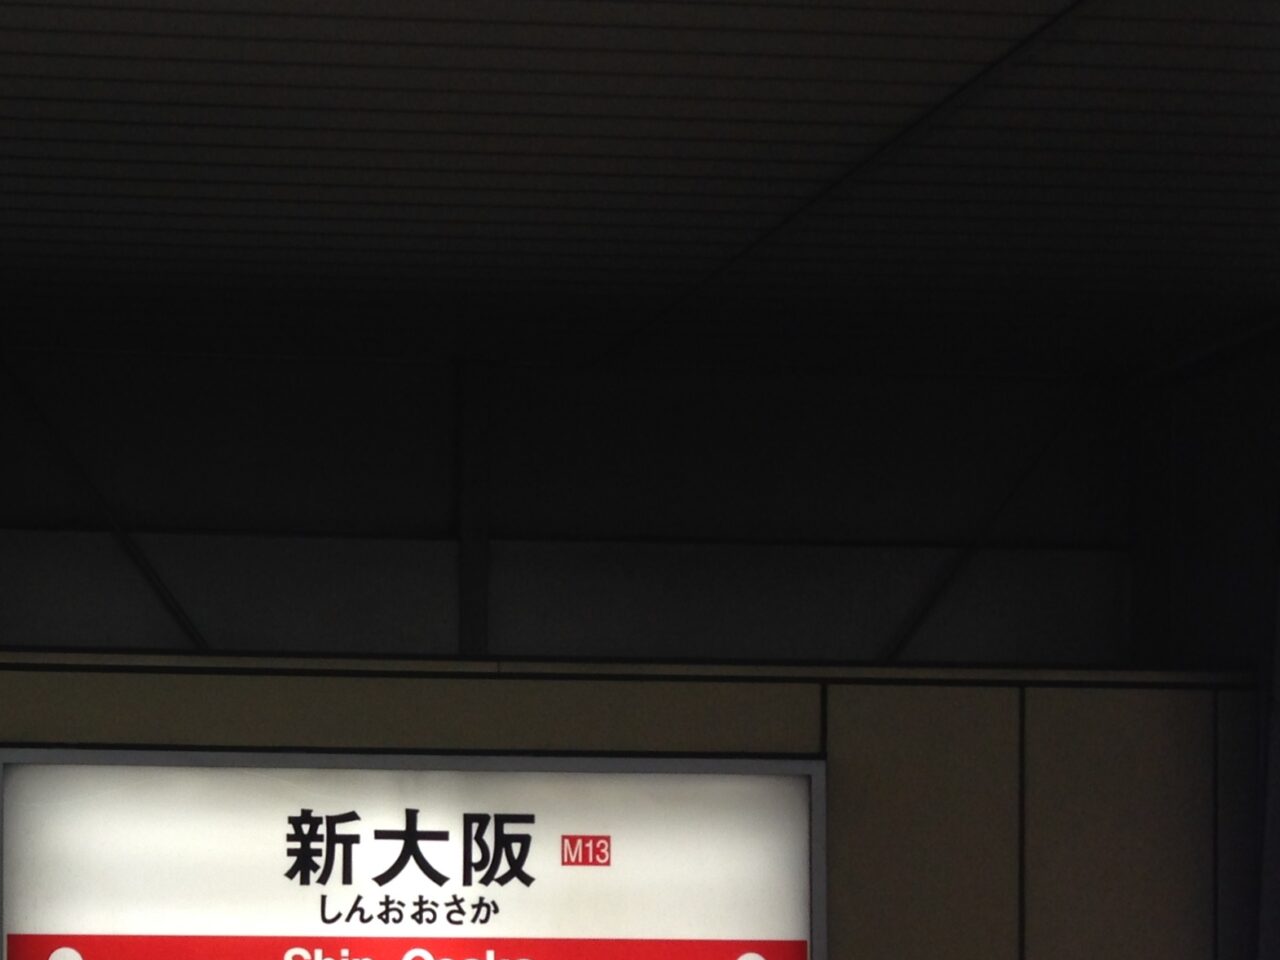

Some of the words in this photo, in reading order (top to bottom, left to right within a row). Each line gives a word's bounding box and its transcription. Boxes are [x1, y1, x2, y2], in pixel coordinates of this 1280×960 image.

[284, 808, 535, 888] 新大阪
[562, 839, 610, 864] M13
[319, 894, 500, 925] しんおおさか
